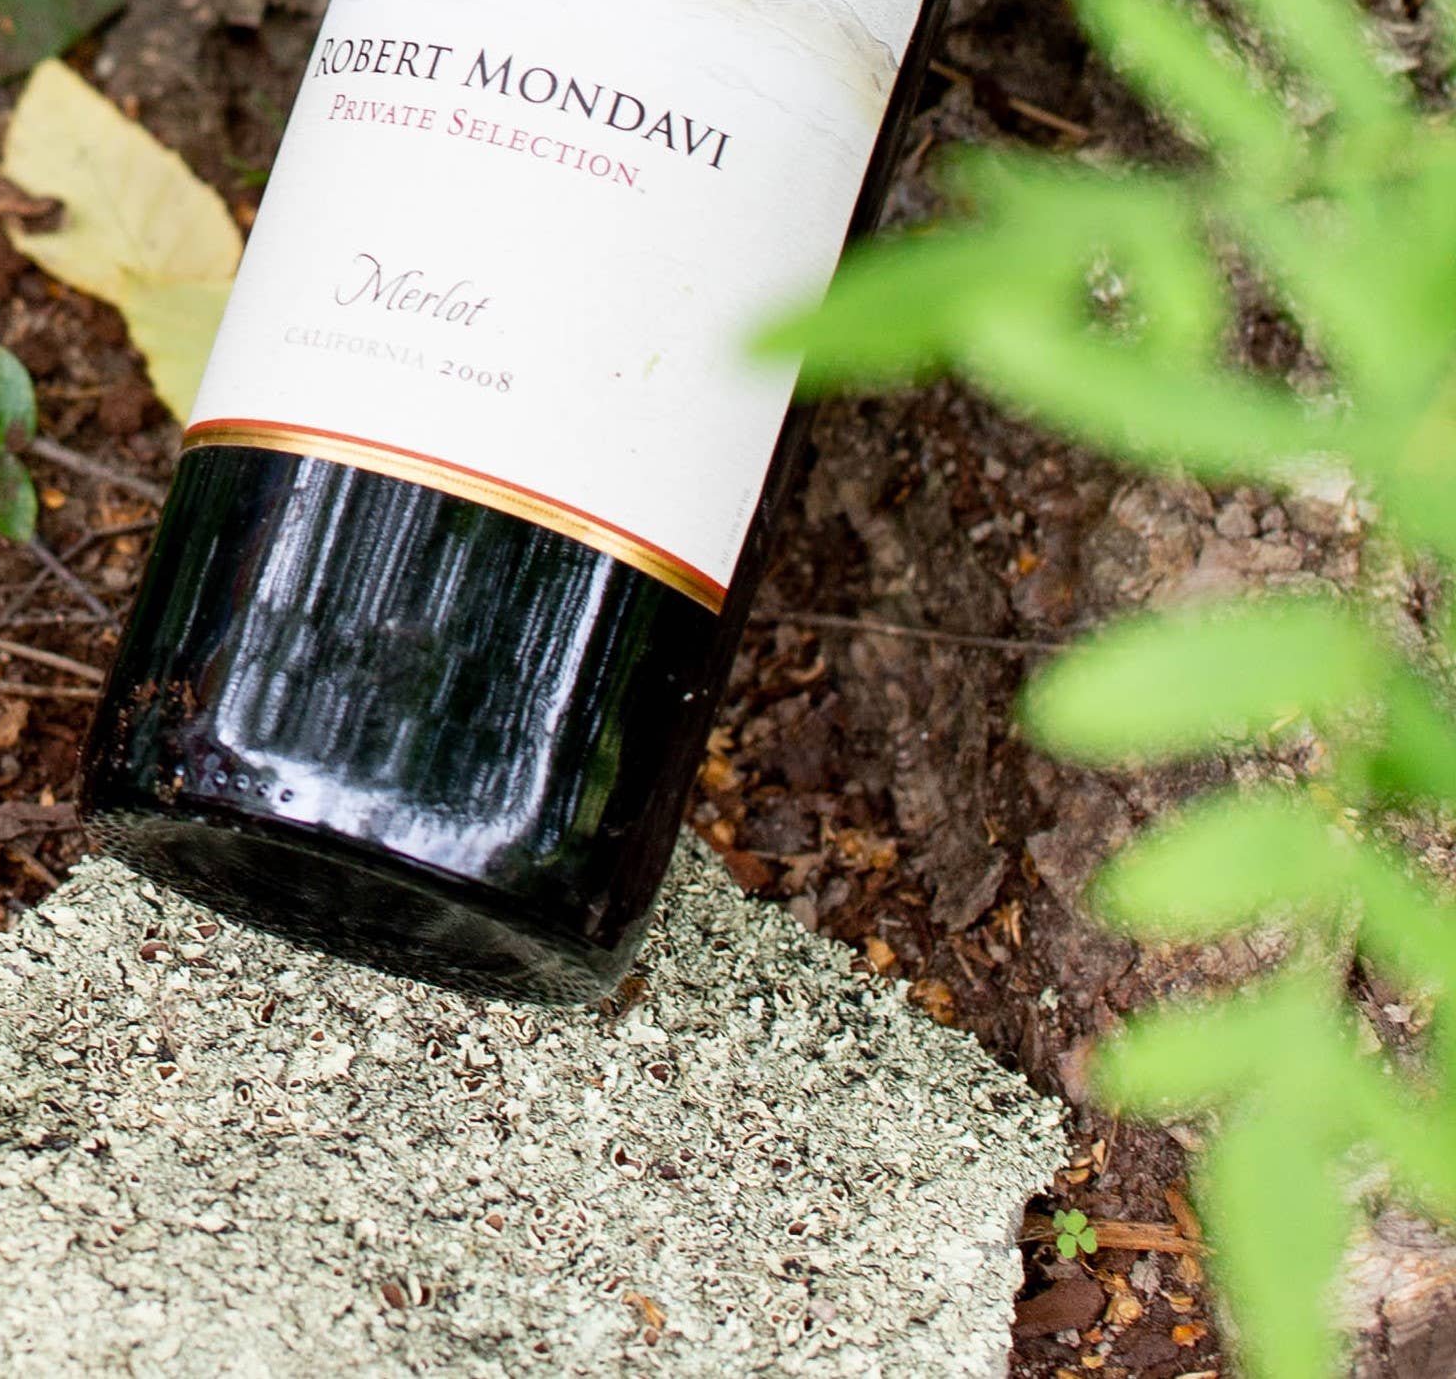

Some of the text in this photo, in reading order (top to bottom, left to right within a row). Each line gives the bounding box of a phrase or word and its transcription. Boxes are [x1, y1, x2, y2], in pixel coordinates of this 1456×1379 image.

[314, 37, 732, 170] ROBERT MONDAVI
[328, 93, 642, 189] PRIVATE SELECTION
[335, 253, 490, 326] Merlot
[284, 325, 514, 393] CALIFORNIA 2008
